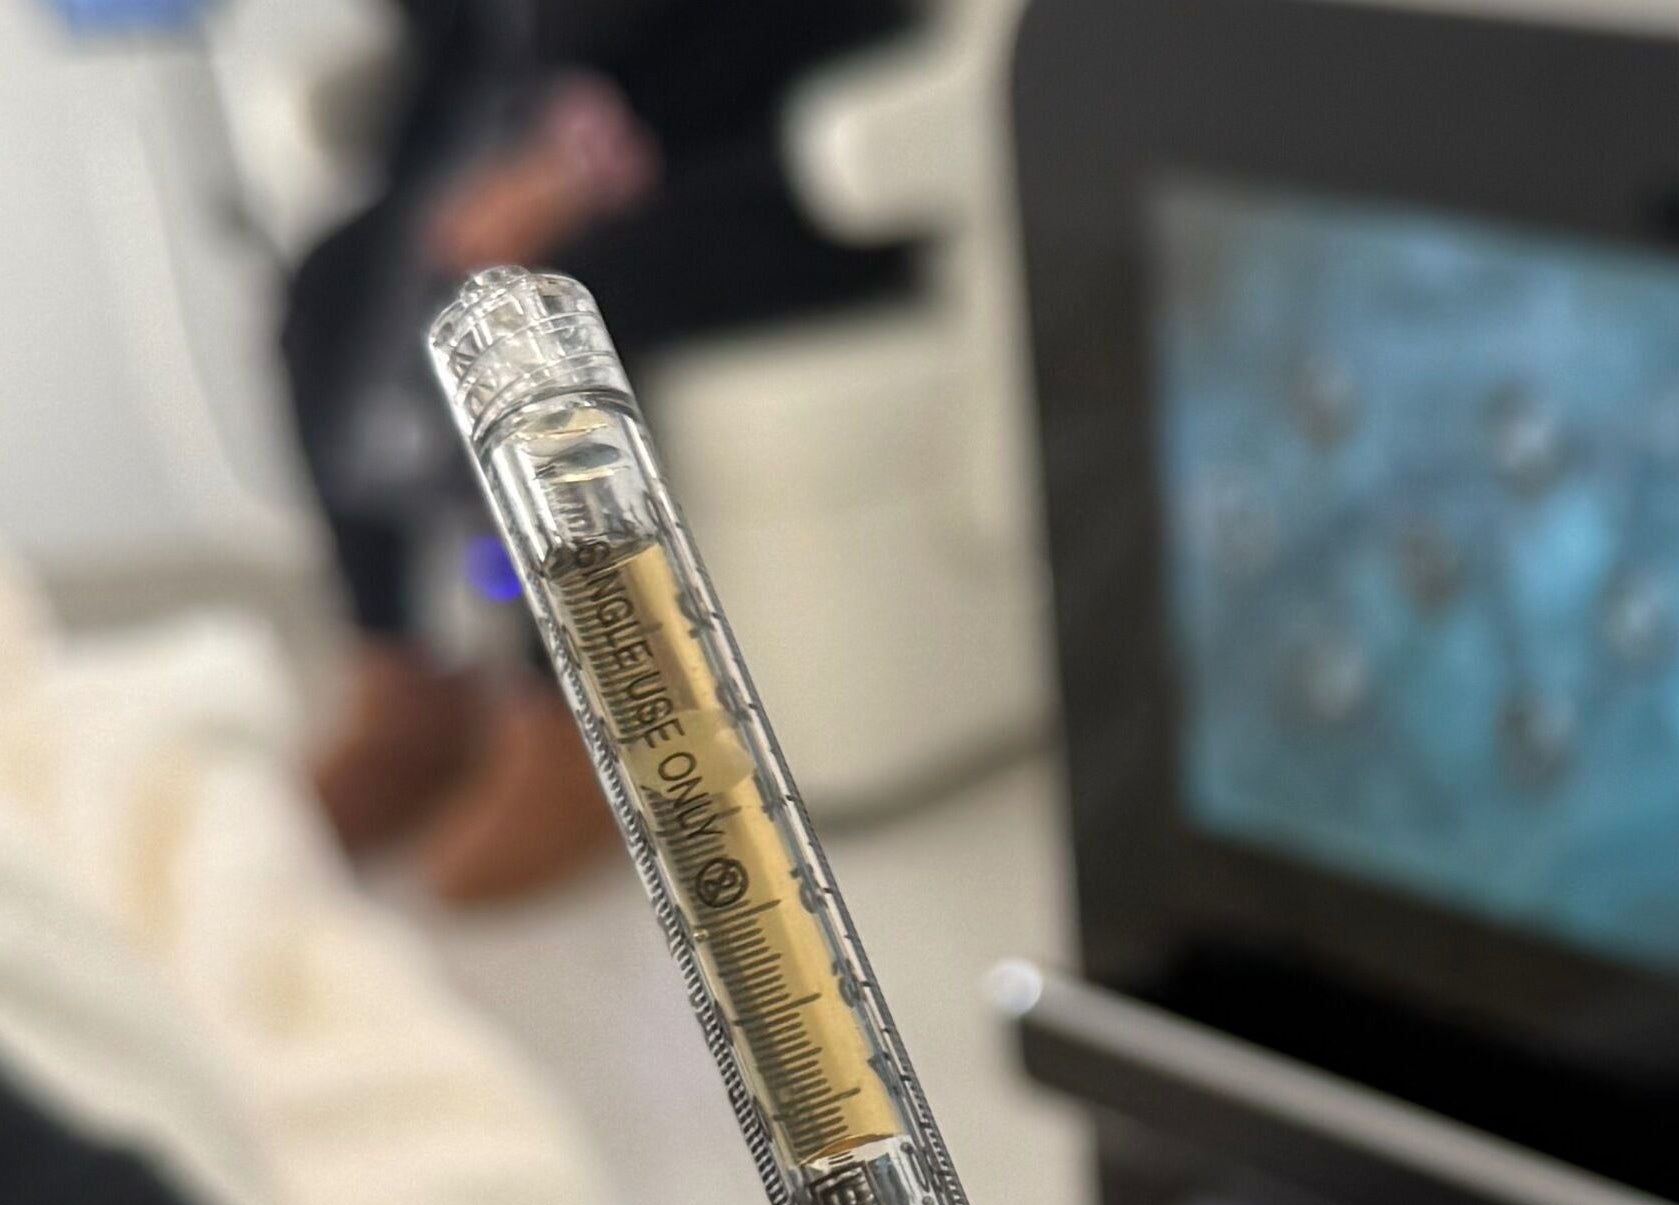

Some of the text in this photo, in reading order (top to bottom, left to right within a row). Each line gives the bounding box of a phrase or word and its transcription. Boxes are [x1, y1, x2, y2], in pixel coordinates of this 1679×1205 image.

[574, 541, 723, 841] SINGLE USE ONLY
